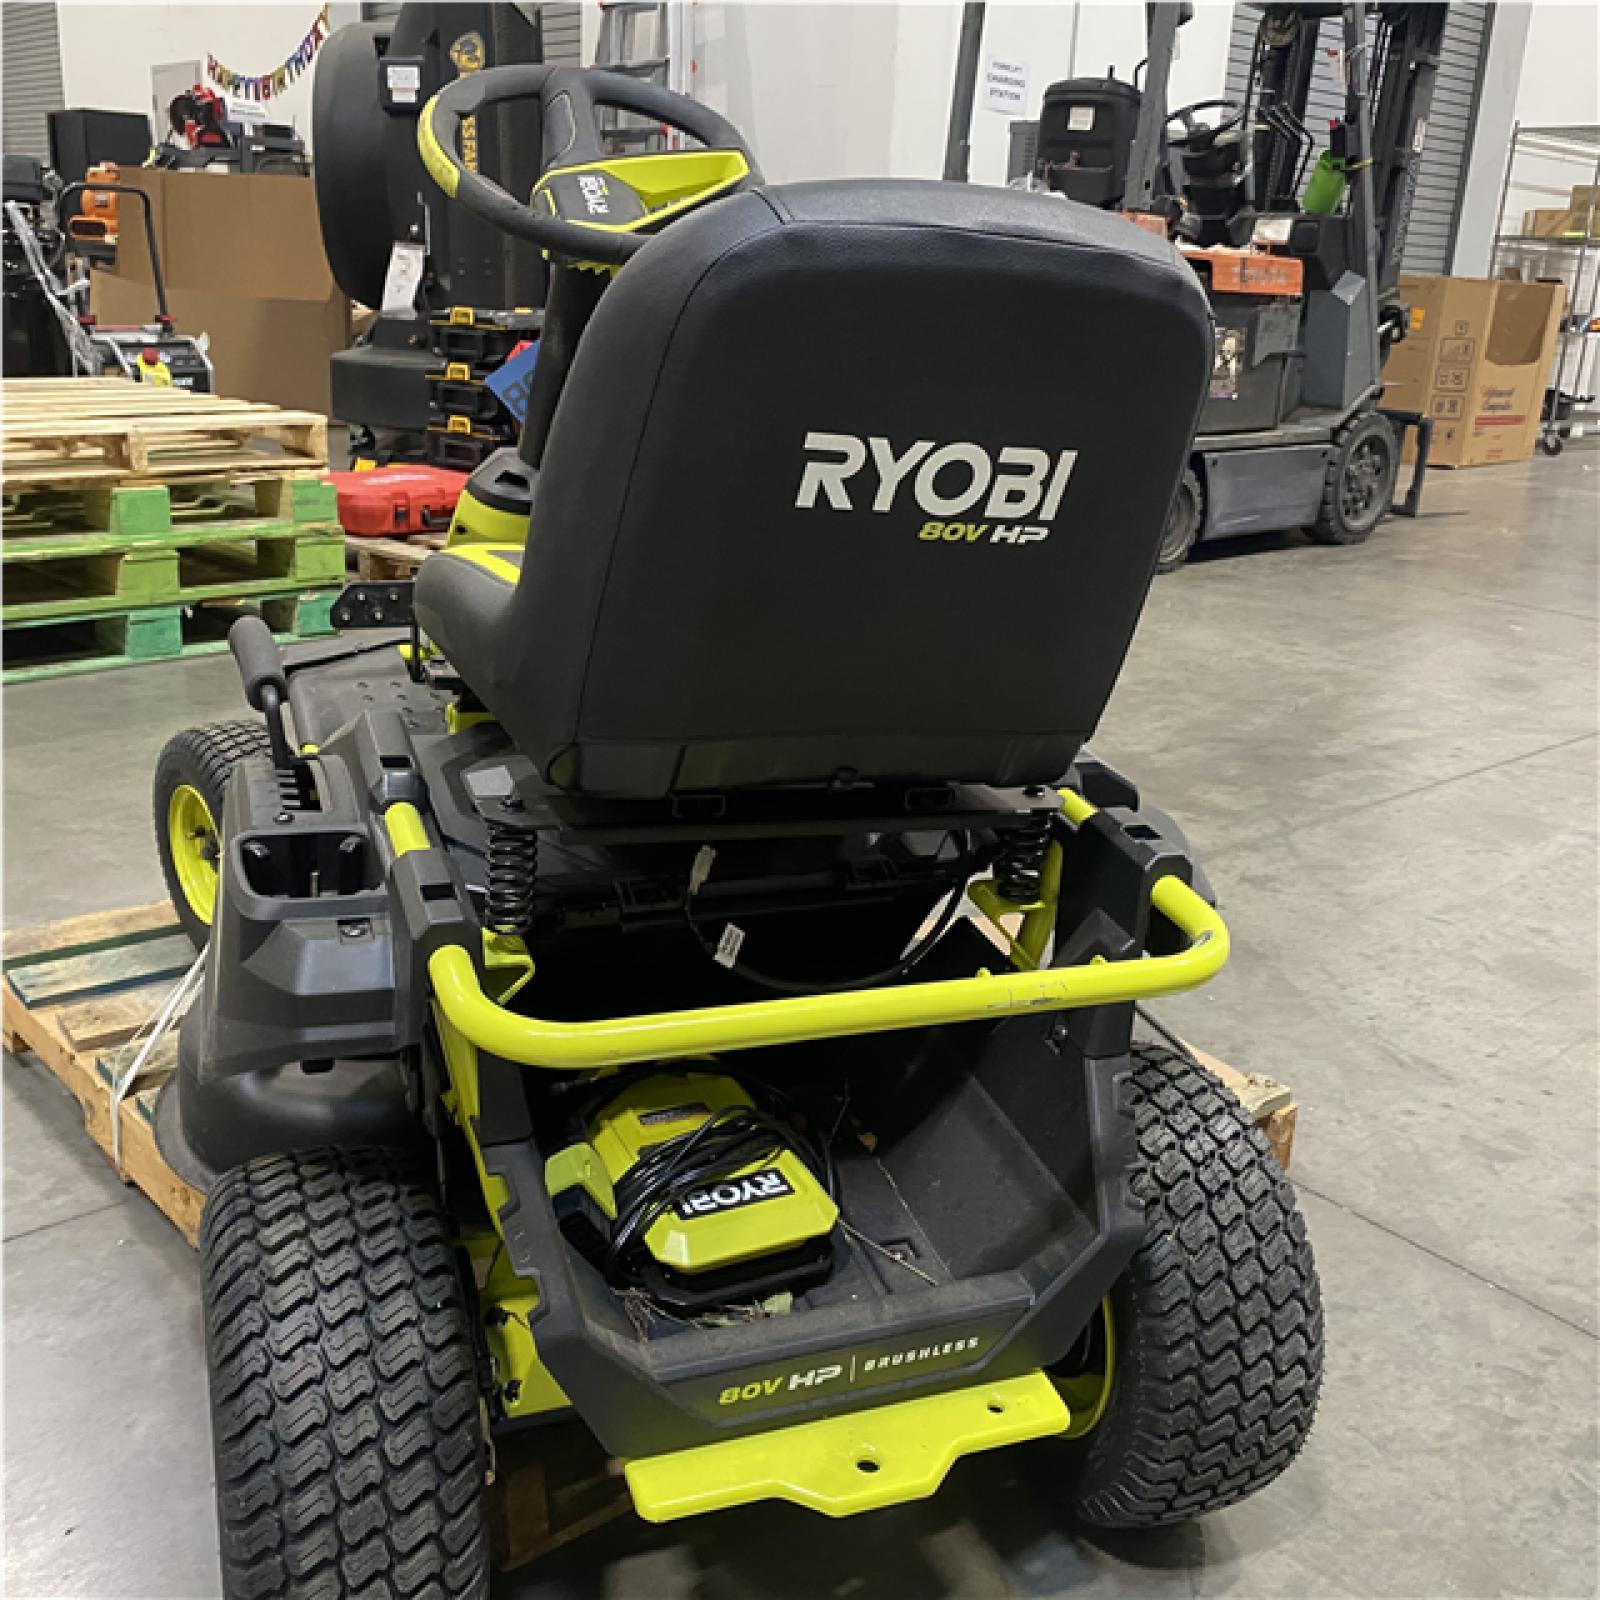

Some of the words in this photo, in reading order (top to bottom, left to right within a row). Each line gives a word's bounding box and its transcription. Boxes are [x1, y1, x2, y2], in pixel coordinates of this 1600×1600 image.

[795, 431, 1078, 520] RYOBI
[918, 521, 989, 542] 80V
[989, 524, 1049, 545] HP
[719, 1376, 783, 1405] 80V
[787, 1364, 843, 1391] HP
[864, 1337, 979, 1371] BRUSHLESS
